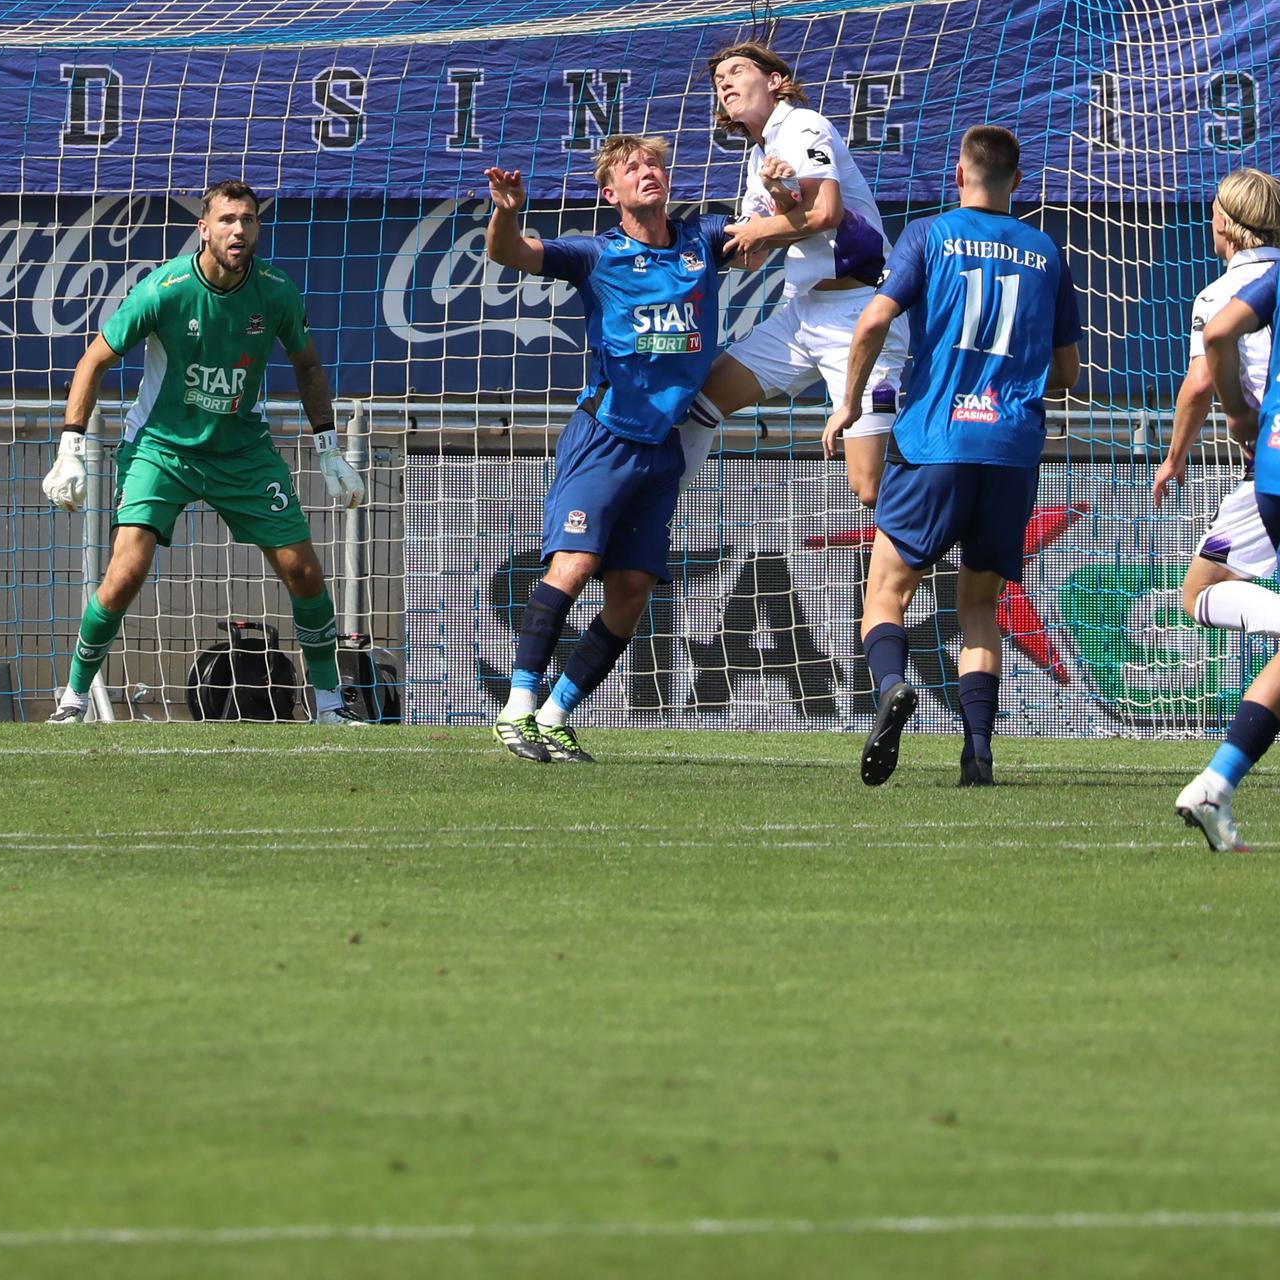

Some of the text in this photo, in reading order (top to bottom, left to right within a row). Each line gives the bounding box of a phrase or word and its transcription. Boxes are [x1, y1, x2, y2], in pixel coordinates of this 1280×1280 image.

[943, 238, 1047, 272] SCHEIDLER
[633, 303, 697, 334] STAR
[953, 268, 1020, 358] 11
[636, 335, 700, 351] SPORT TV
[184, 363, 247, 395] STAR
[186, 391, 229, 411] SPORT
[953, 394, 993, 411] STAR
